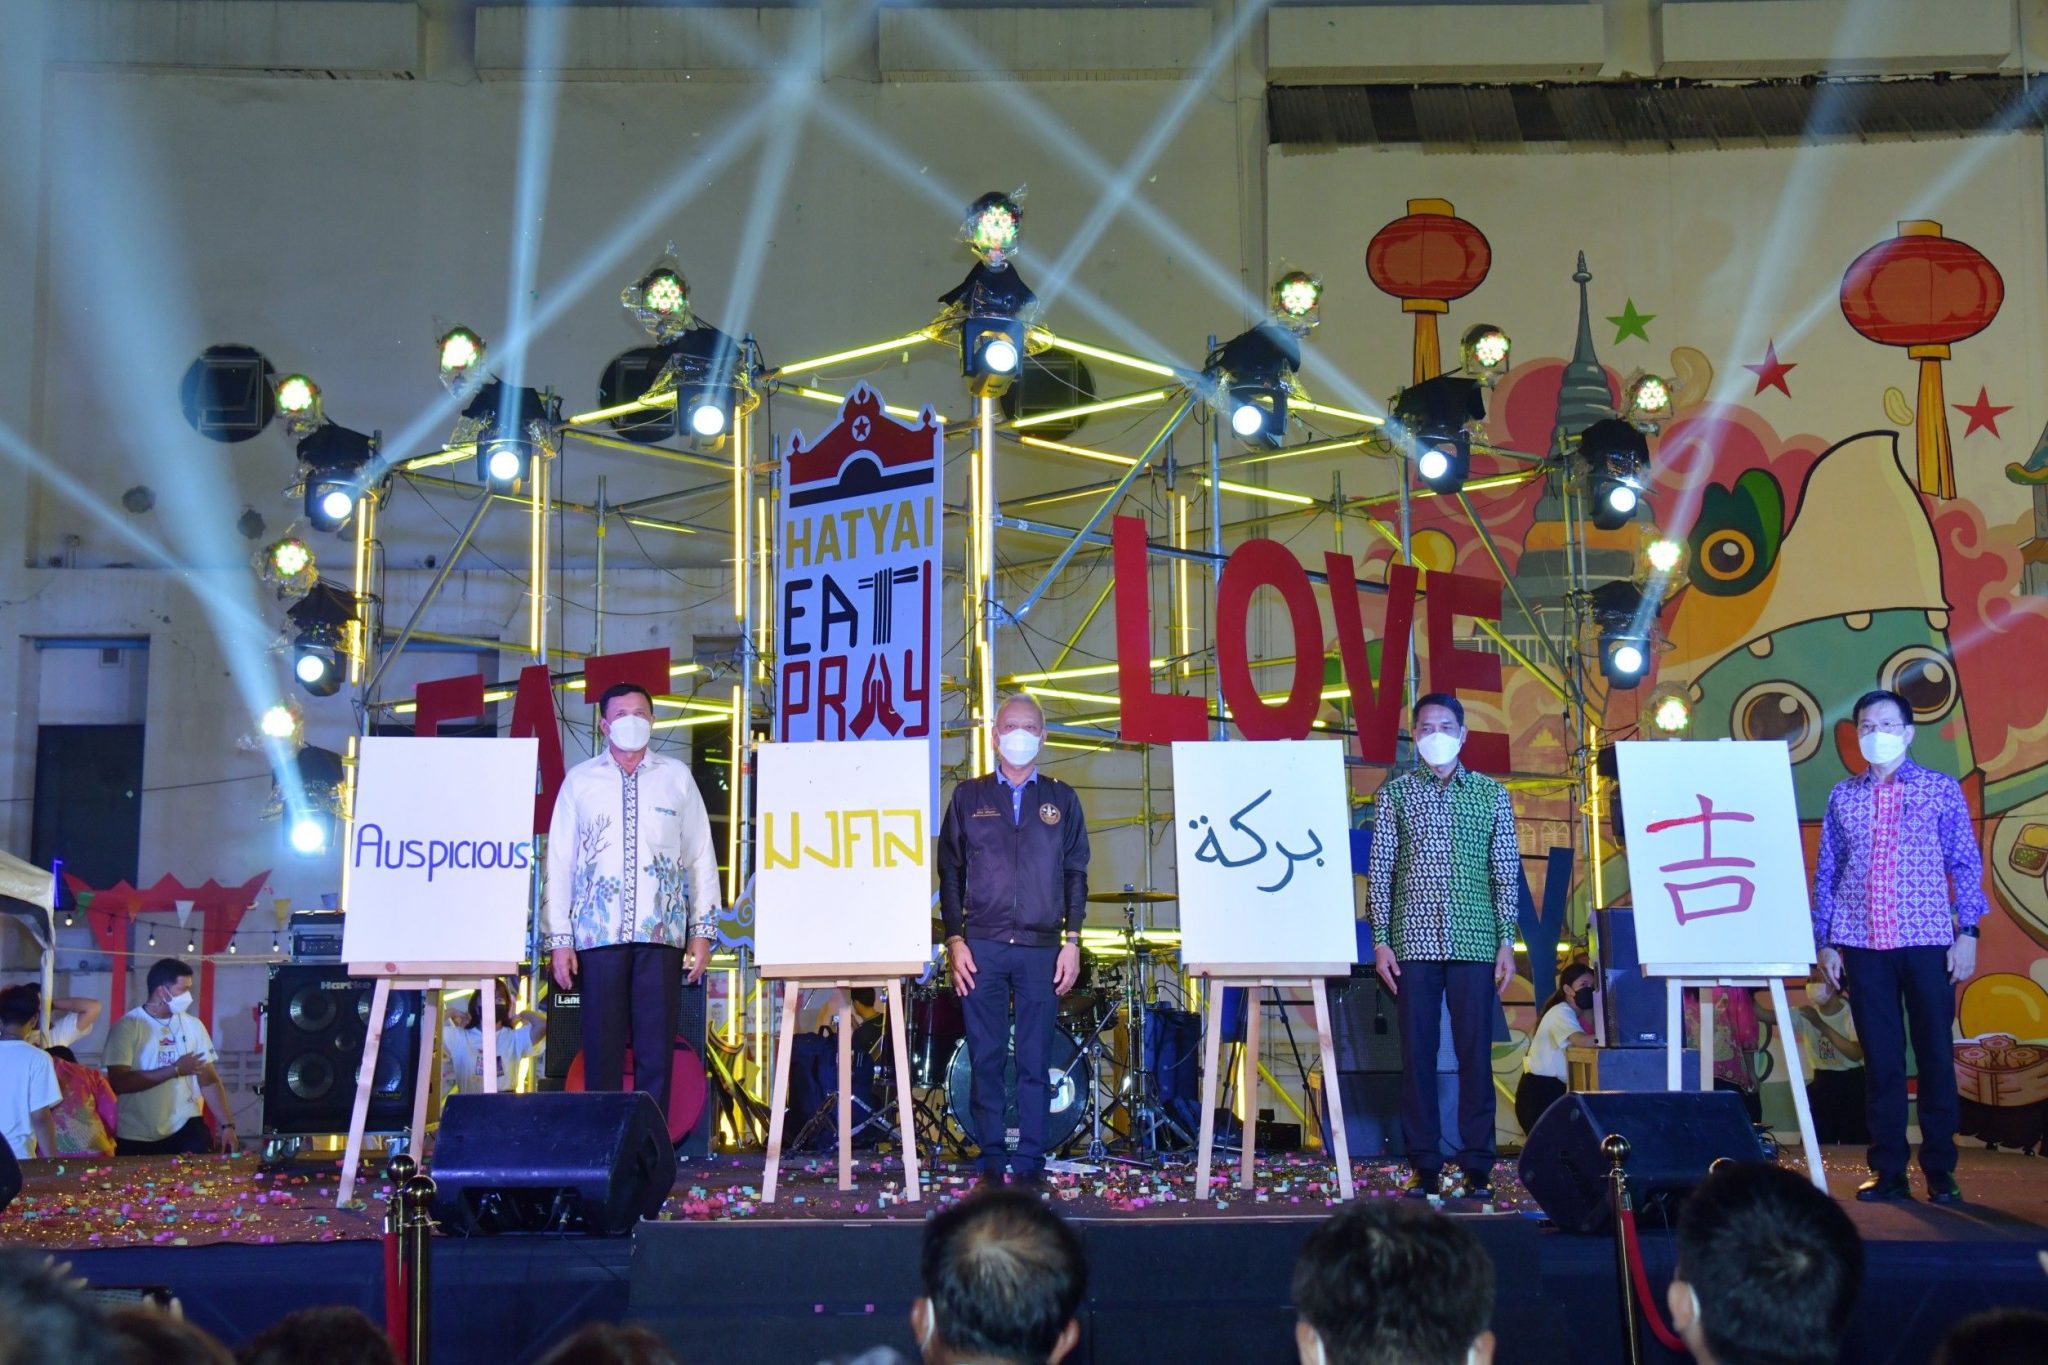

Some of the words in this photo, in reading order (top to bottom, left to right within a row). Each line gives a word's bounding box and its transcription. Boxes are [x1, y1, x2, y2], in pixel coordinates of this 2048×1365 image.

[786, 496, 934, 570] HATYAI
[784, 565, 919, 657] EAT
[1112, 514, 1511, 774] LOVE
[763, 809, 924, 870] มงคล
[1188, 788, 1325, 893] بركة
[1645, 793, 1756, 926] 吉
